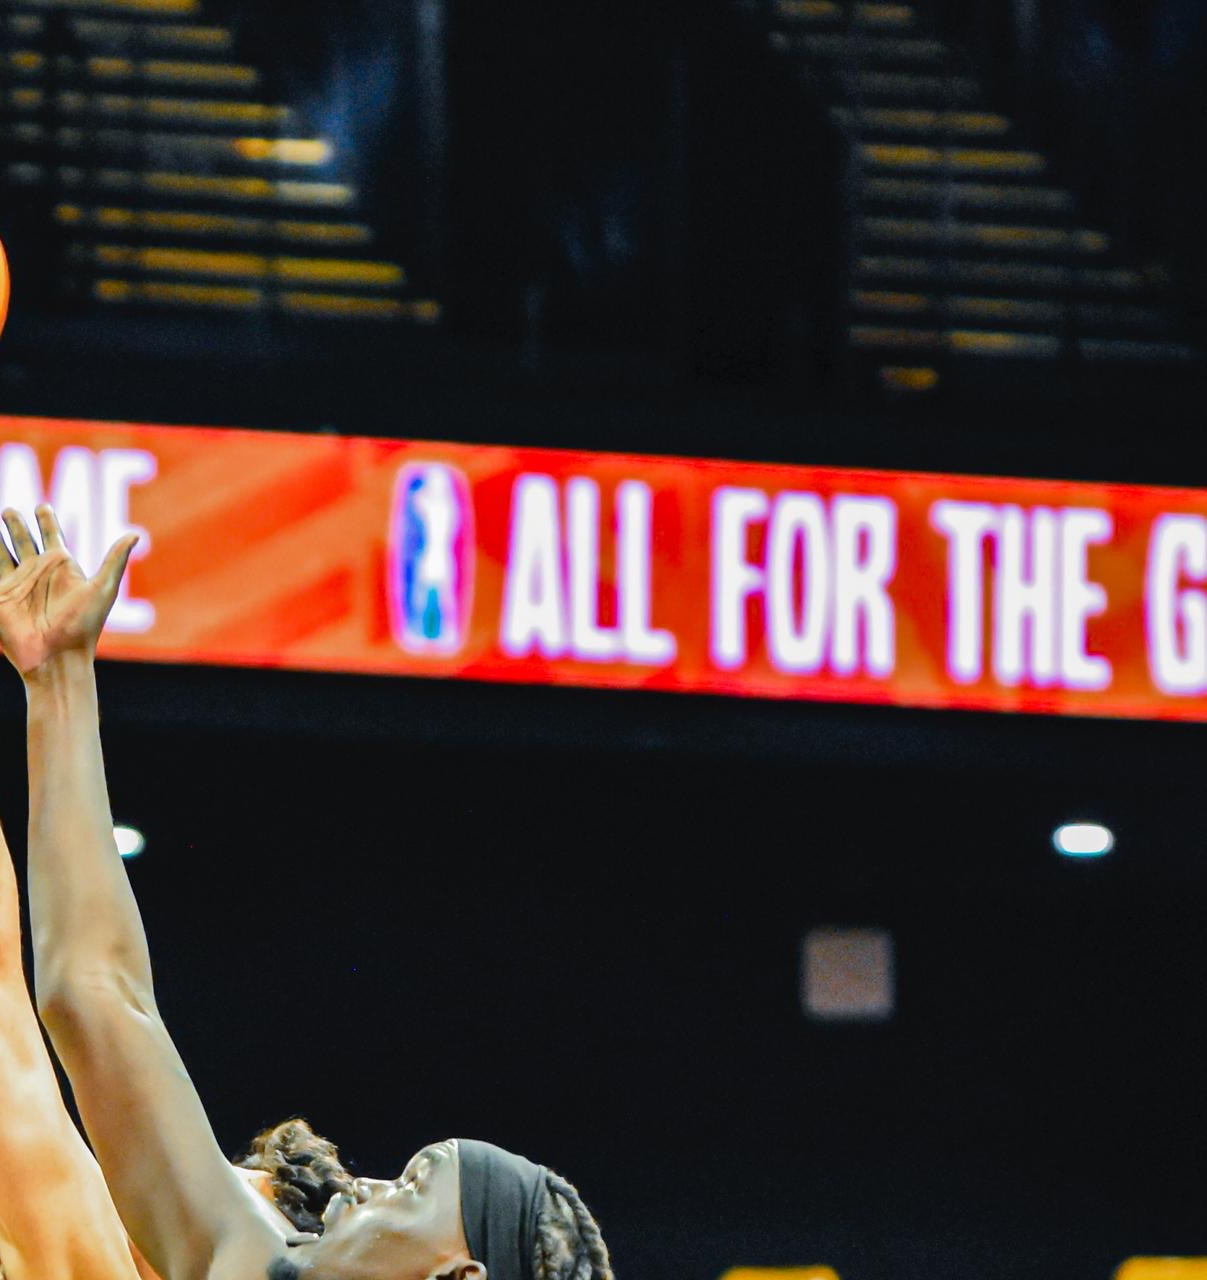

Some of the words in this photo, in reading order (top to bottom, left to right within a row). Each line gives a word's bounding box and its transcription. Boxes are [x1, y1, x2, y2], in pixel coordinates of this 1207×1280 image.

[501, 474, 676, 665] ALL
[711, 486, 896, 677] FOR
[930, 500, 1113, 691] THE
